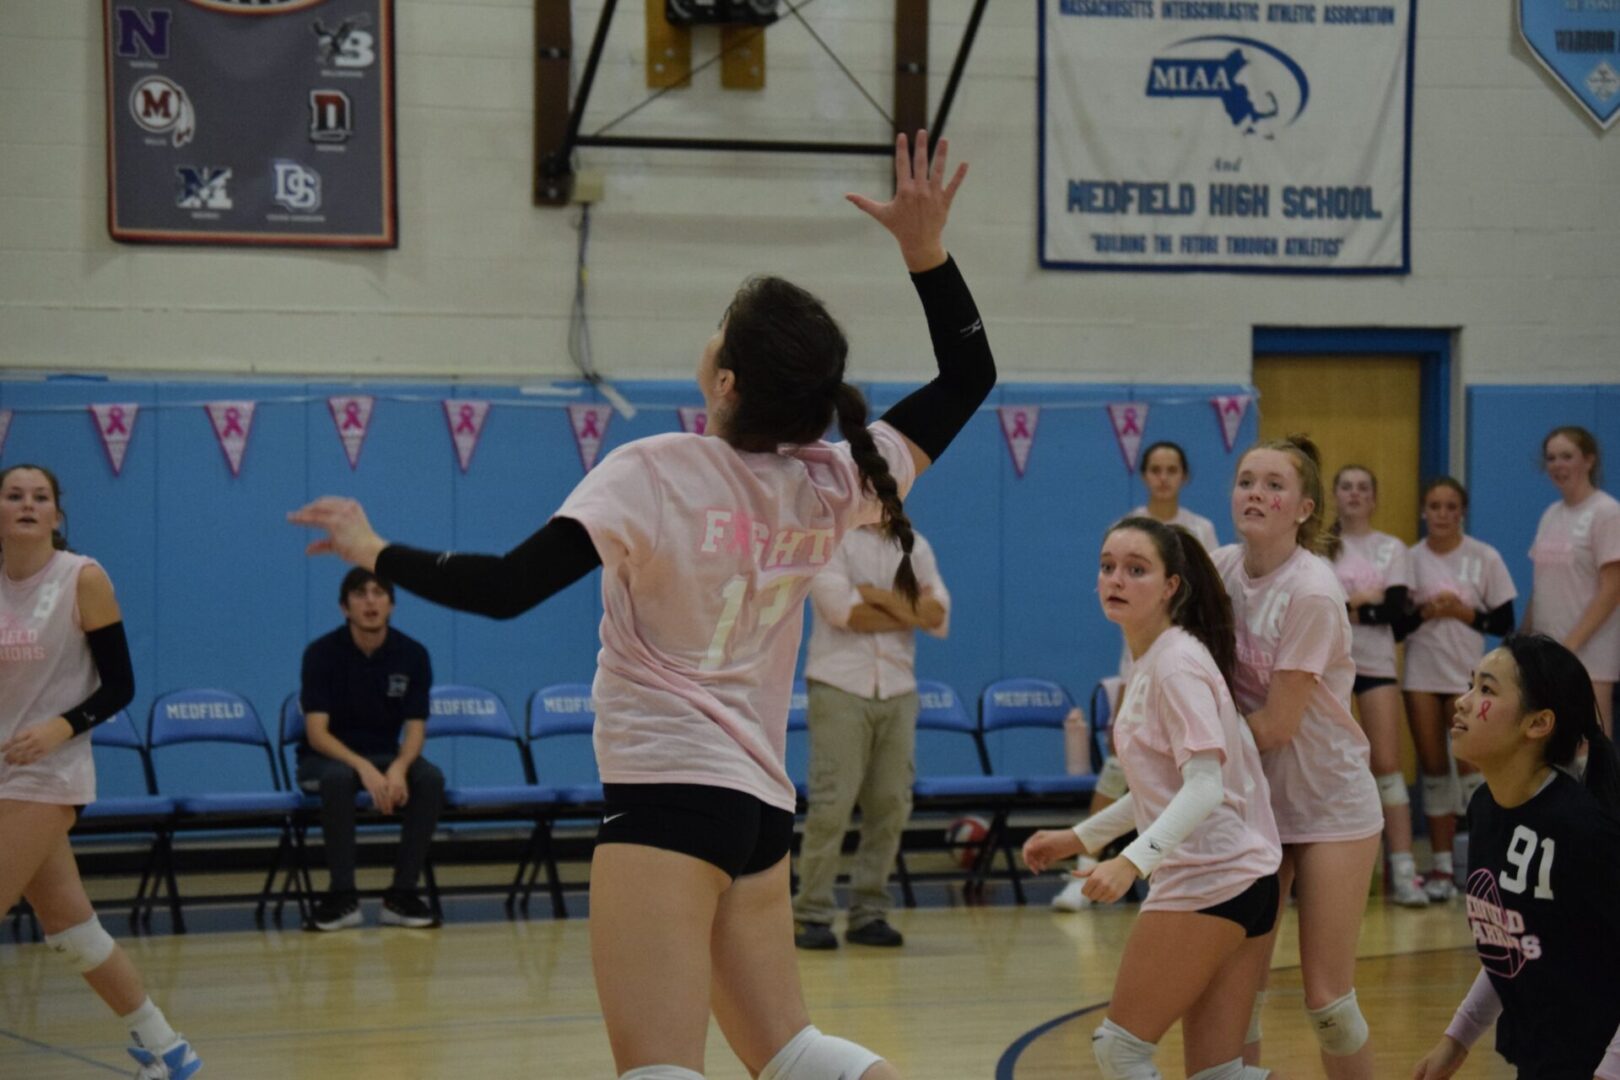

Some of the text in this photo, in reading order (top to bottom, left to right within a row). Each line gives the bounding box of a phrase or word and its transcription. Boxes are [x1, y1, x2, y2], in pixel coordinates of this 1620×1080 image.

[1267, 4, 1317, 24] ATHLETIC
[1323, 6, 1395, 25] ASSOCIATION
[117, 7, 171, 57] N
[1153, 65, 1231, 90] MIAA
[141, 89, 172, 119] M
[1210, 156, 1242, 172] And
[1066, 179, 1382, 220] MEDFIELD HIGH SCHOOL
[166, 703, 245, 719] MEDFIELD
[992, 691, 1062, 707] MEDFIELD
[1499, 824, 1555, 900] 91
